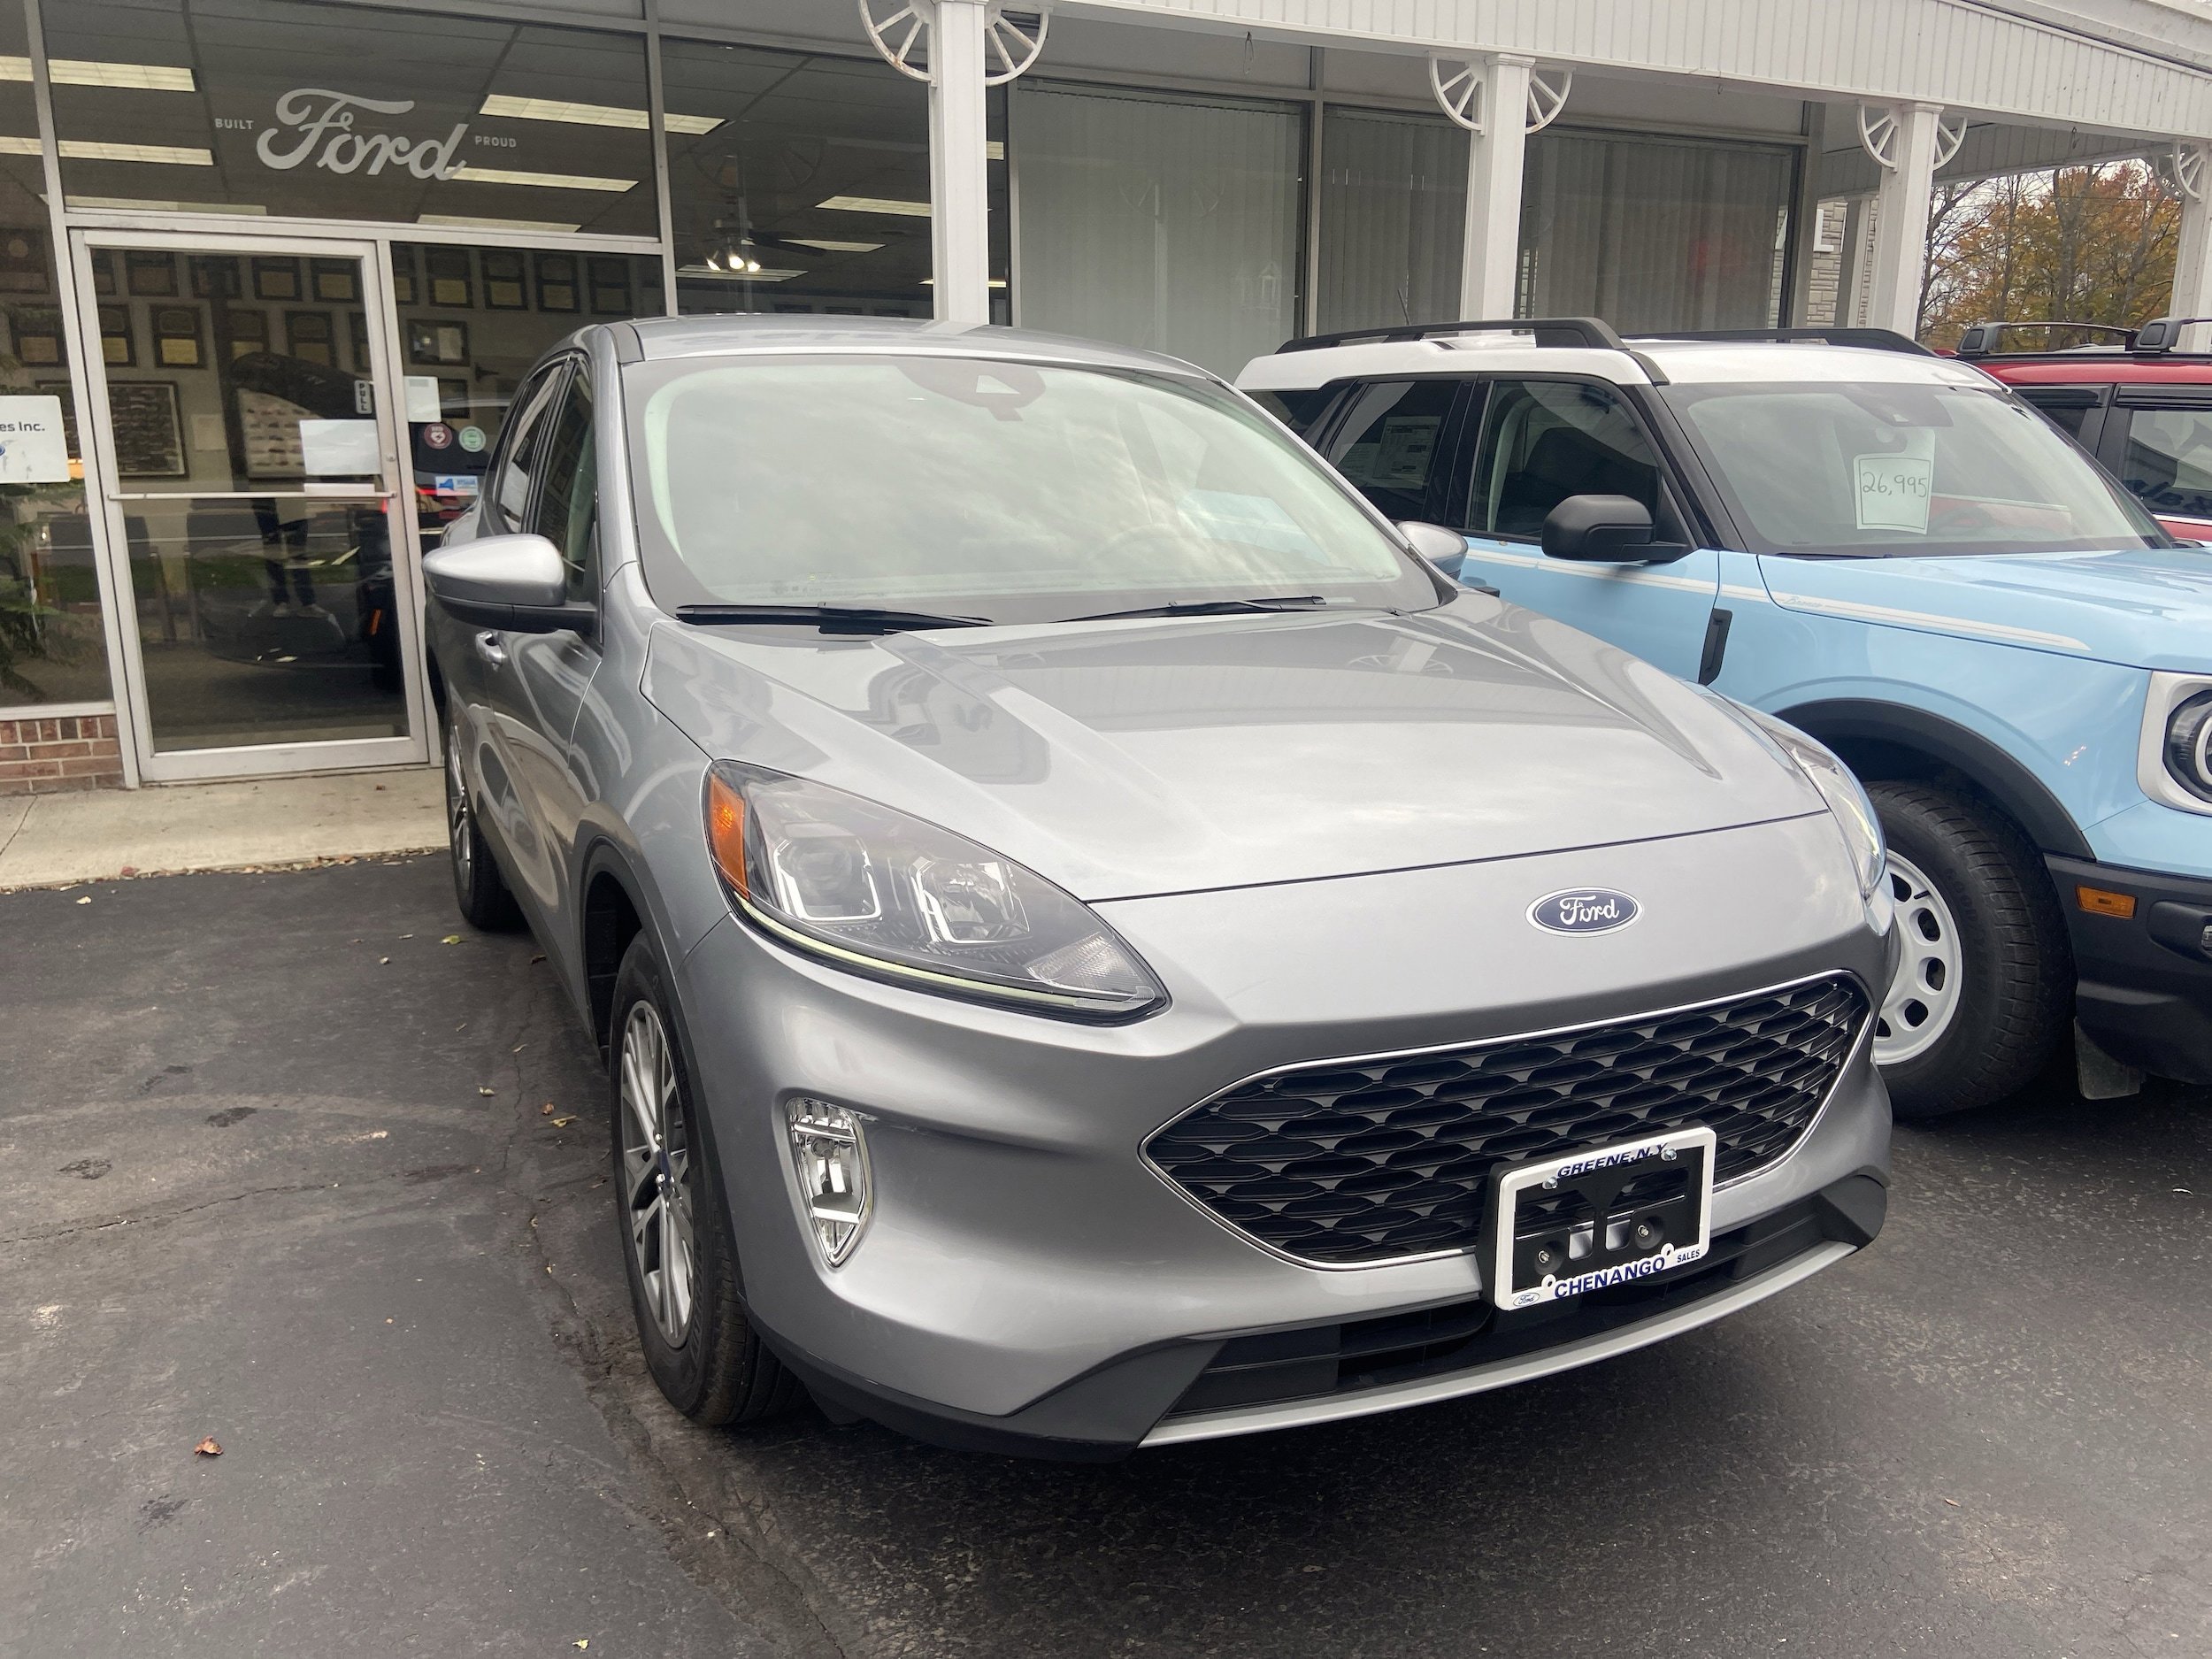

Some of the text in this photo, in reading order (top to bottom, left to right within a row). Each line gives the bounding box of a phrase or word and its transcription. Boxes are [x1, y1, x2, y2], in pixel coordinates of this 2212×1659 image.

[214, 88, 518, 180] BUILT Ford PROUD
[358, 382, 367, 411] PULL
[19, 421, 45, 432] Inc.
[1862, 472, 1928, 498] 26,995
[1559, 895, 1620, 926] Ford
[1554, 1248, 1701, 1299] CHENANGO SALES
